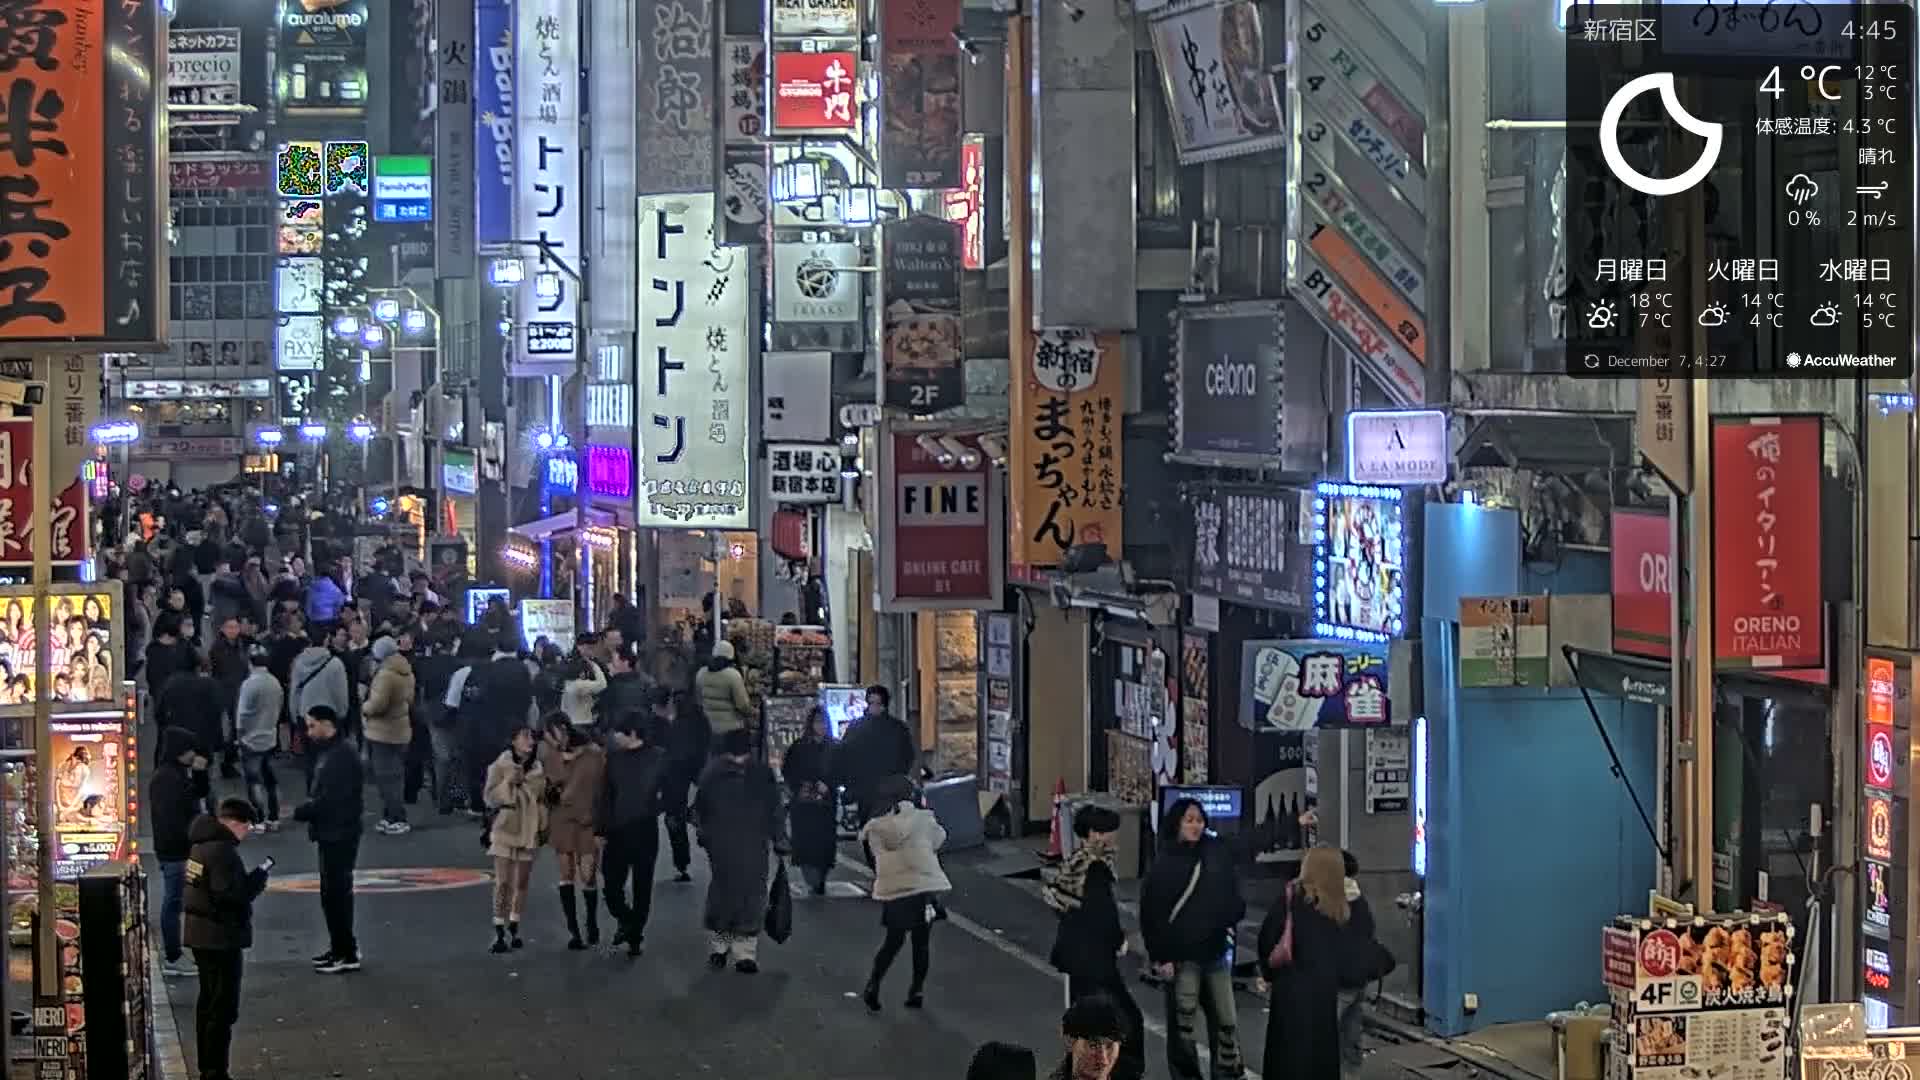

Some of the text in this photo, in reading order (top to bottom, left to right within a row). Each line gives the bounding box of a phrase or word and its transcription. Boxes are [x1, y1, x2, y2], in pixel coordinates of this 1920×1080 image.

[287, 11, 362, 26] auralume
[1306, 22, 1328, 43] 5
[1306, 75, 1326, 92] 4
[1306, 122, 1327, 143] 3
[1306, 172, 1327, 194] 2
[1303, 269, 1332, 298] B1
[652, 208, 686, 464] トントン
[1205, 359, 1257, 398] celona
[910, 384, 940, 406] 2F
[772, 450, 837, 473] 酒場心
[1033, 396, 1079, 549] まっちゃん
[903, 485, 979, 515] FINE
[1746, 430, 1782, 606] 俺のイタリアン
[903, 560, 948, 576] ONLINE
[1733, 615, 1801, 633] ORENO
[1731, 634, 1802, 652] ITALIAN
[1301, 655, 1387, 720] 麻雀
[1640, 982, 1673, 1005] 4F
[1704, 984, 1784, 1008] 炭火焼き鳥
[34, 1007, 65, 1026] NERO
[37, 1038, 68, 1057] NERO
